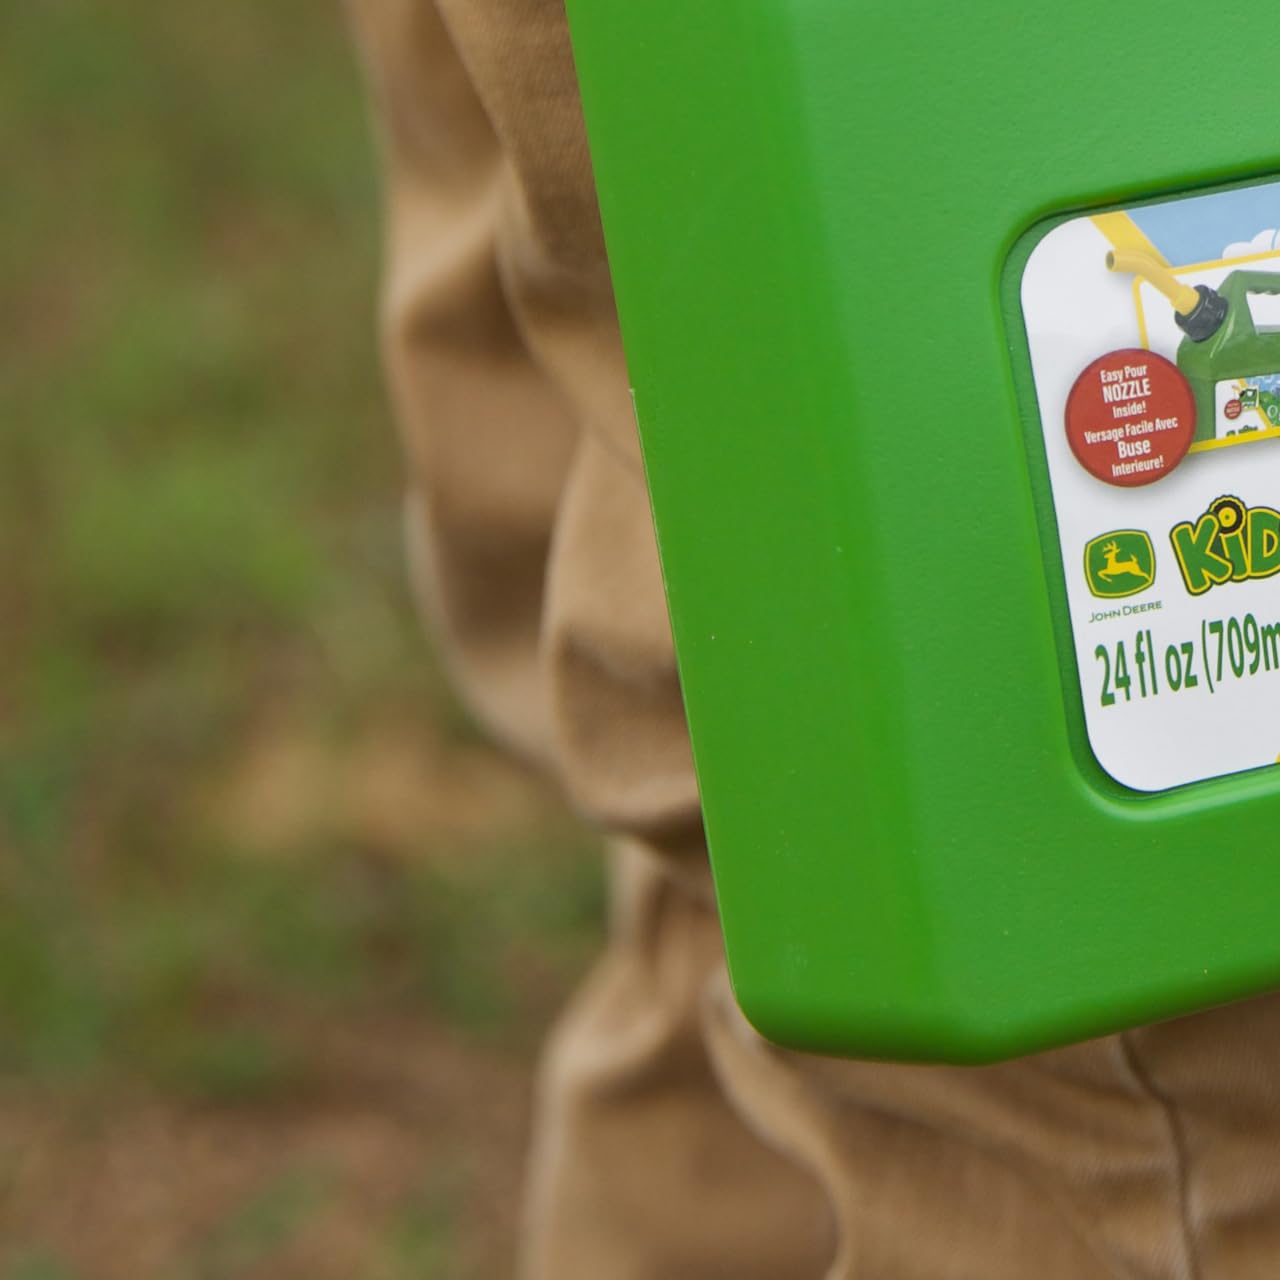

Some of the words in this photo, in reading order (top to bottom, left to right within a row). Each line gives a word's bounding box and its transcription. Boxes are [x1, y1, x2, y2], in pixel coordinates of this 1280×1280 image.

[1100, 369, 1123, 382] Easy
[1124, 365, 1147, 378] Pour
[1102, 378, 1152, 403] NOZZLE
[1113, 400, 1146, 418] Inside!
[1084, 429, 1124, 444] Versage
[1125, 422, 1154, 436] Facile
[1156, 417, 1178, 431] Avec
[1117, 440, 1152, 459] Buse
[1112, 455, 1164, 477] Interieure!
[1089, 608, 1121, 623] JOHN
[1122, 600, 1163, 616] DEERE
[1095, 640, 1131, 707] 24
[1135, 629, 1158, 698] fl
[1165, 641, 1198, 692] oz
